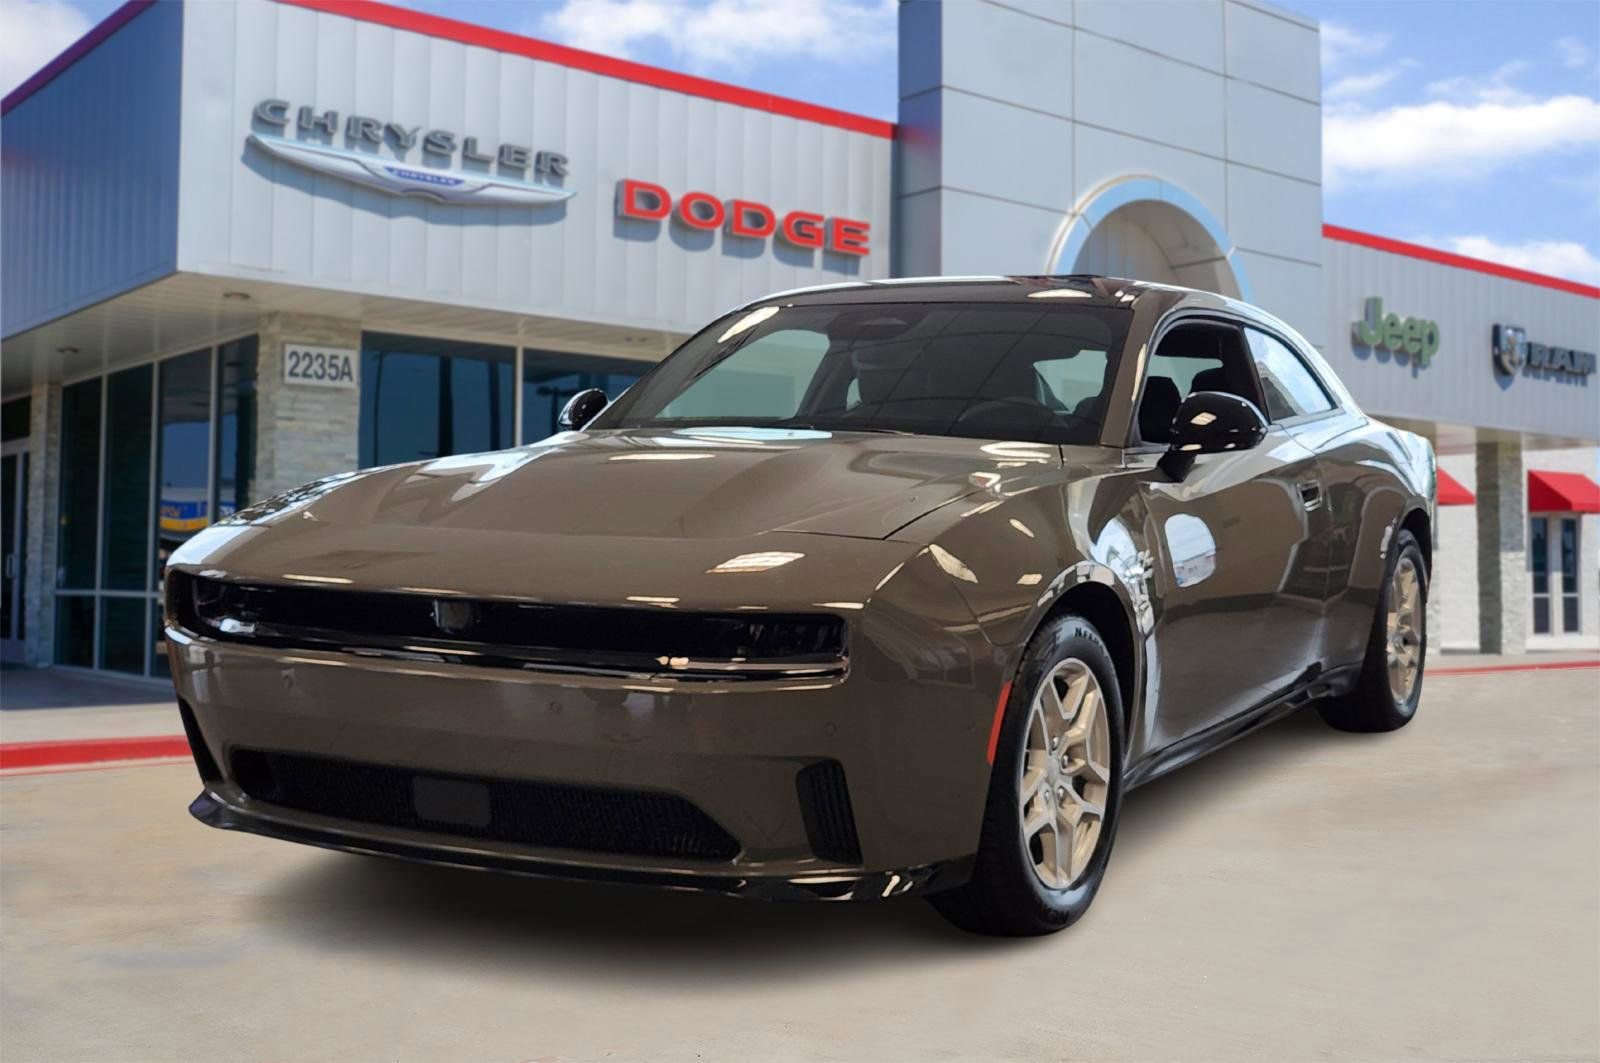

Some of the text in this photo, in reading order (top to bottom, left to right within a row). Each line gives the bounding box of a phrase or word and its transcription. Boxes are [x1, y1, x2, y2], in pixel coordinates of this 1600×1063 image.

[252, 98, 569, 177] CHRYSLER
[616, 179, 870, 256] DODGE
[1353, 296, 1440, 365] Jeep
[1526, 342, 1597, 376] RAM
[288, 350, 354, 382] 2235A
